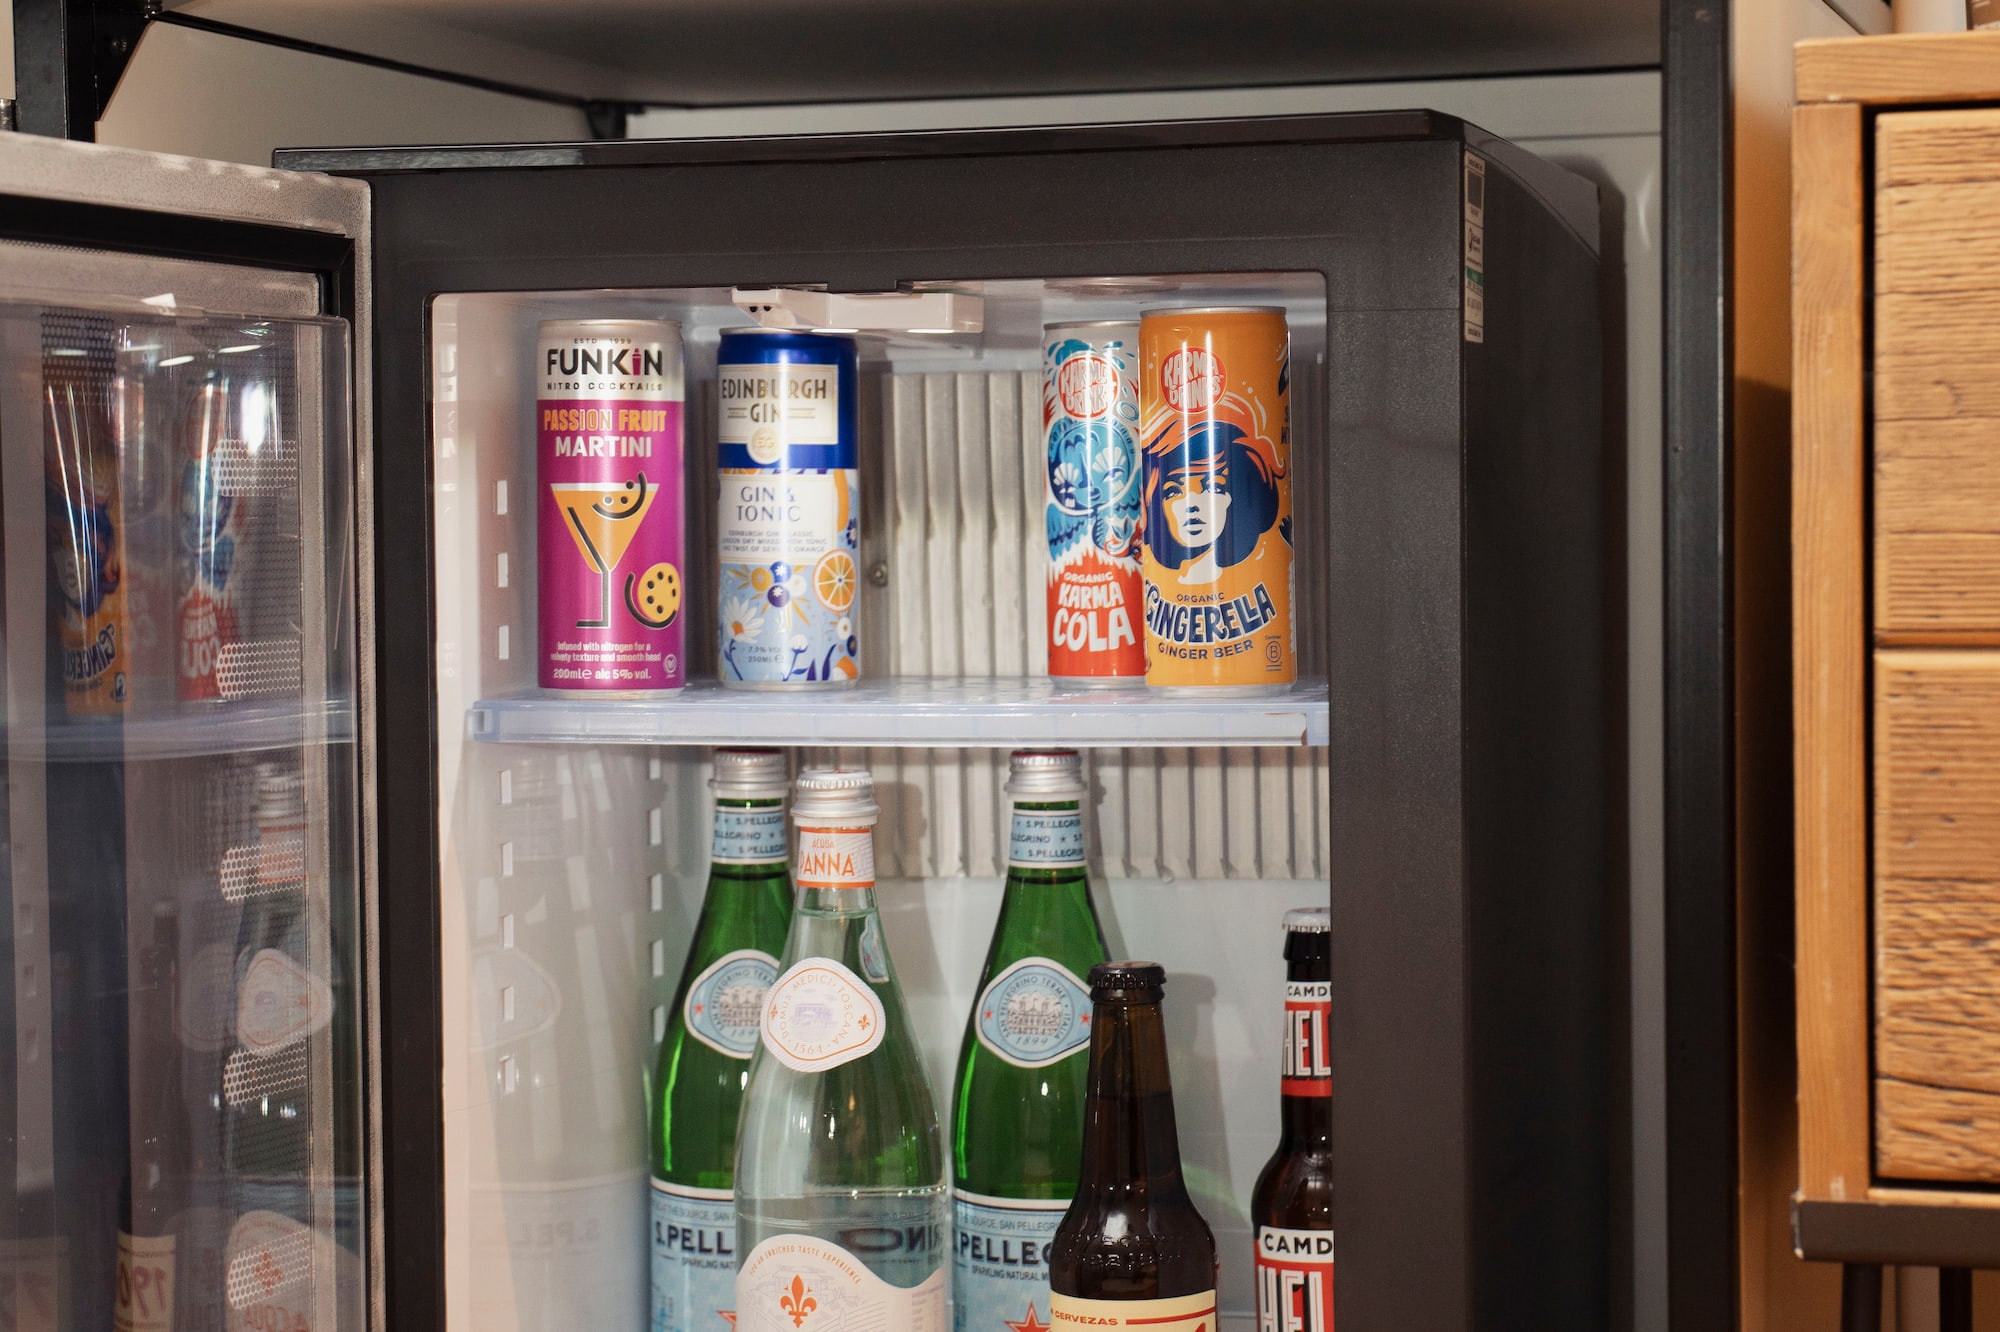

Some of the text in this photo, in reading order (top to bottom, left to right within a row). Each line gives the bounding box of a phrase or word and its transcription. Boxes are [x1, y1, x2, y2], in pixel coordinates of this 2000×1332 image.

[1163, 351, 1220, 388] KARMA
[547, 382, 663, 391] NITRO COCKTAILS
[543, 408, 667, 432] PASSION FRUIT
[555, 436, 652, 458] MARTINI
[741, 486, 775, 502] GIN
[737, 505, 800, 522] TONIC
[1064, 572, 1114, 583] ORGANIC
[1059, 582, 1124, 610] KARMA
[1176, 592, 1225, 603] ORGANIC
[1145, 581, 1278, 645] GINGERELLA
[1053, 607, 1136, 652] COLA
[583, 641, 599, 652] with
[600, 641, 633, 654] nitrogen
[634, 641, 645, 651] for
[646, 643, 651, 651] a
[1158, 640, 1254, 660] GINGER BEER
[573, 652, 599, 661] texture
[600, 652, 615, 661] and
[616, 653, 644, 662] smooth
[595, 668, 610, 679] alc
[613, 668, 633, 679] 5%
[634, 668, 651, 679] vol.
[812, 837, 834, 849] ACQUA
[1041, 977, 1067, 1000] TERME
[1287, 985, 1331, 997] CAMD
[793, 974, 833, 991] MEDICI
[835, 986, 854, 1045] TOSCANA
[1264, 1233, 1333, 1255] CAMD
[798, 1245, 819, 1257] TASTE
[822, 1252, 862, 1284] EXPERIENCE
[1006, 1270, 1040, 1281] NATURAL
[1055, 1310, 1118, 1326] CERVEZAS
